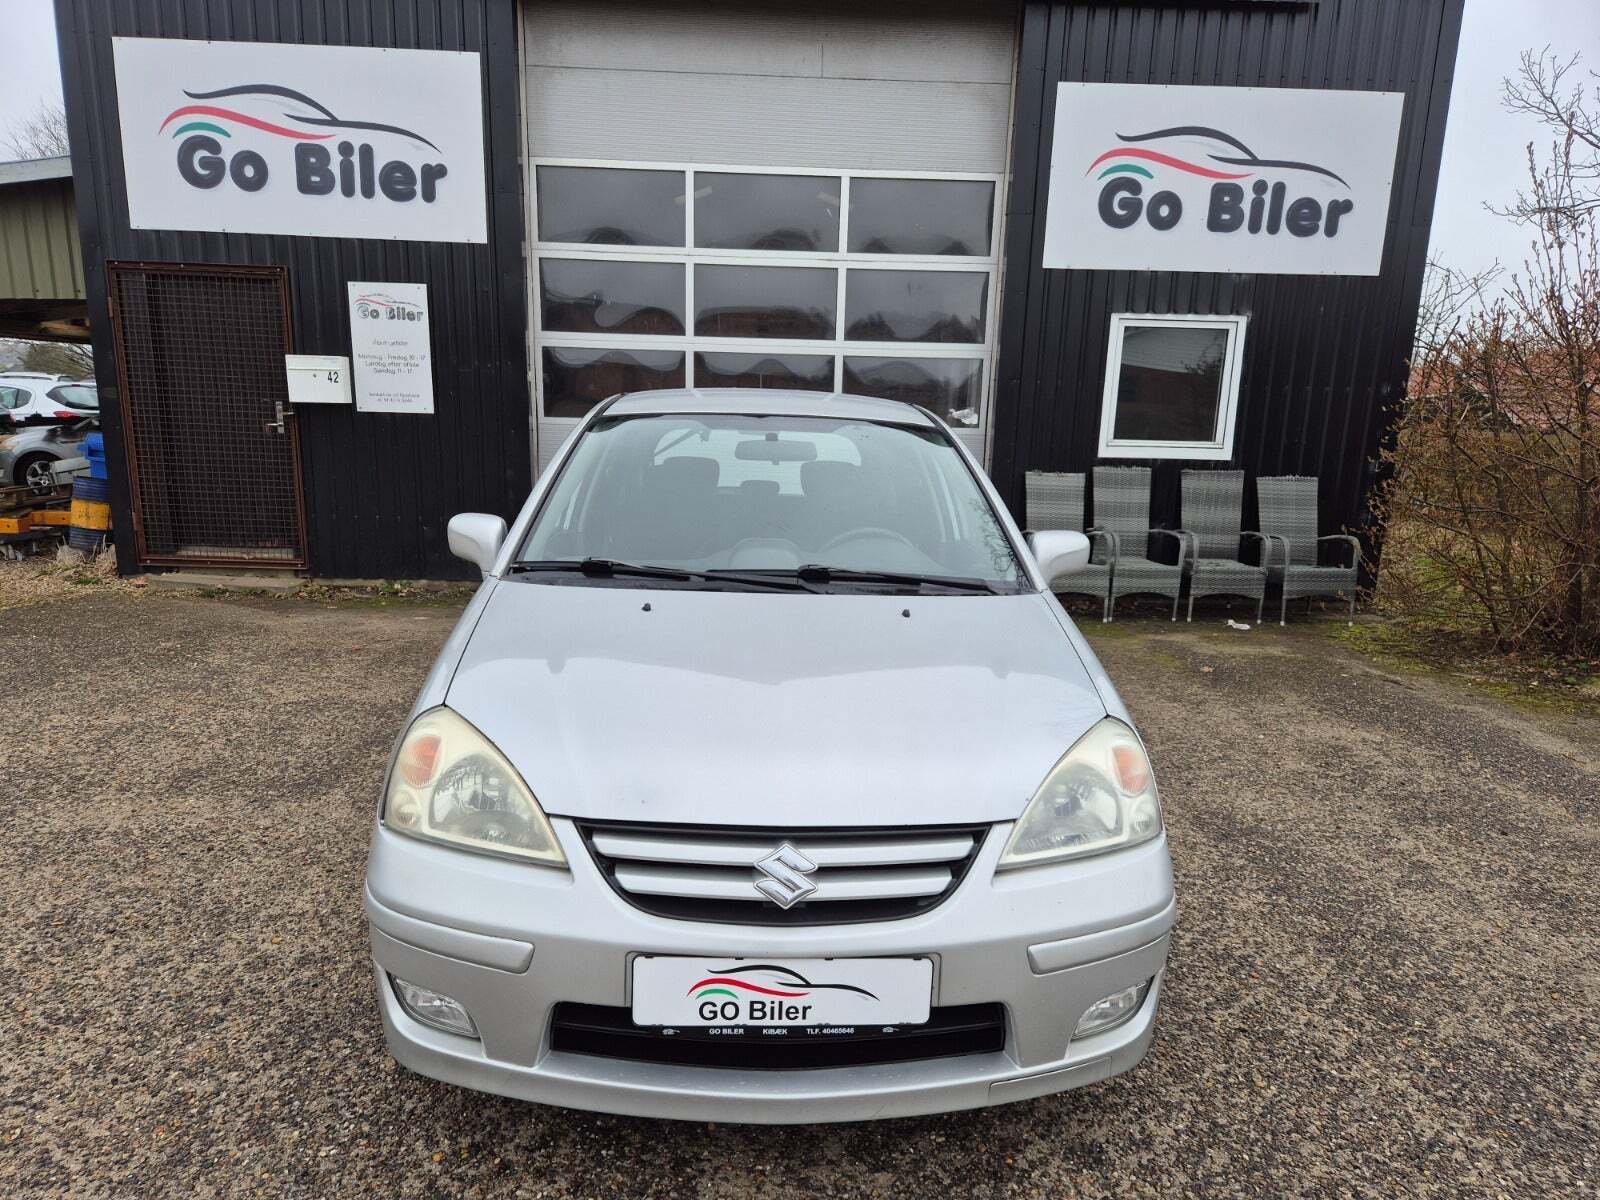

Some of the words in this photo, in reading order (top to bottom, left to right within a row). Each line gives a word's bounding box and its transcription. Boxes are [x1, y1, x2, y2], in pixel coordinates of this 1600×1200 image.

[177, 134, 269, 193] Go
[294, 140, 448, 203] Biler
[1098, 176, 1183, 231] Go
[1206, 179, 1354, 239] Biler
[357, 304, 380, 320] Go
[386, 306, 424, 322] Biler
[327, 371, 339, 384] 42
[698, 1001, 740, 1021] GO
[749, 1000, 812, 1021] Biler
